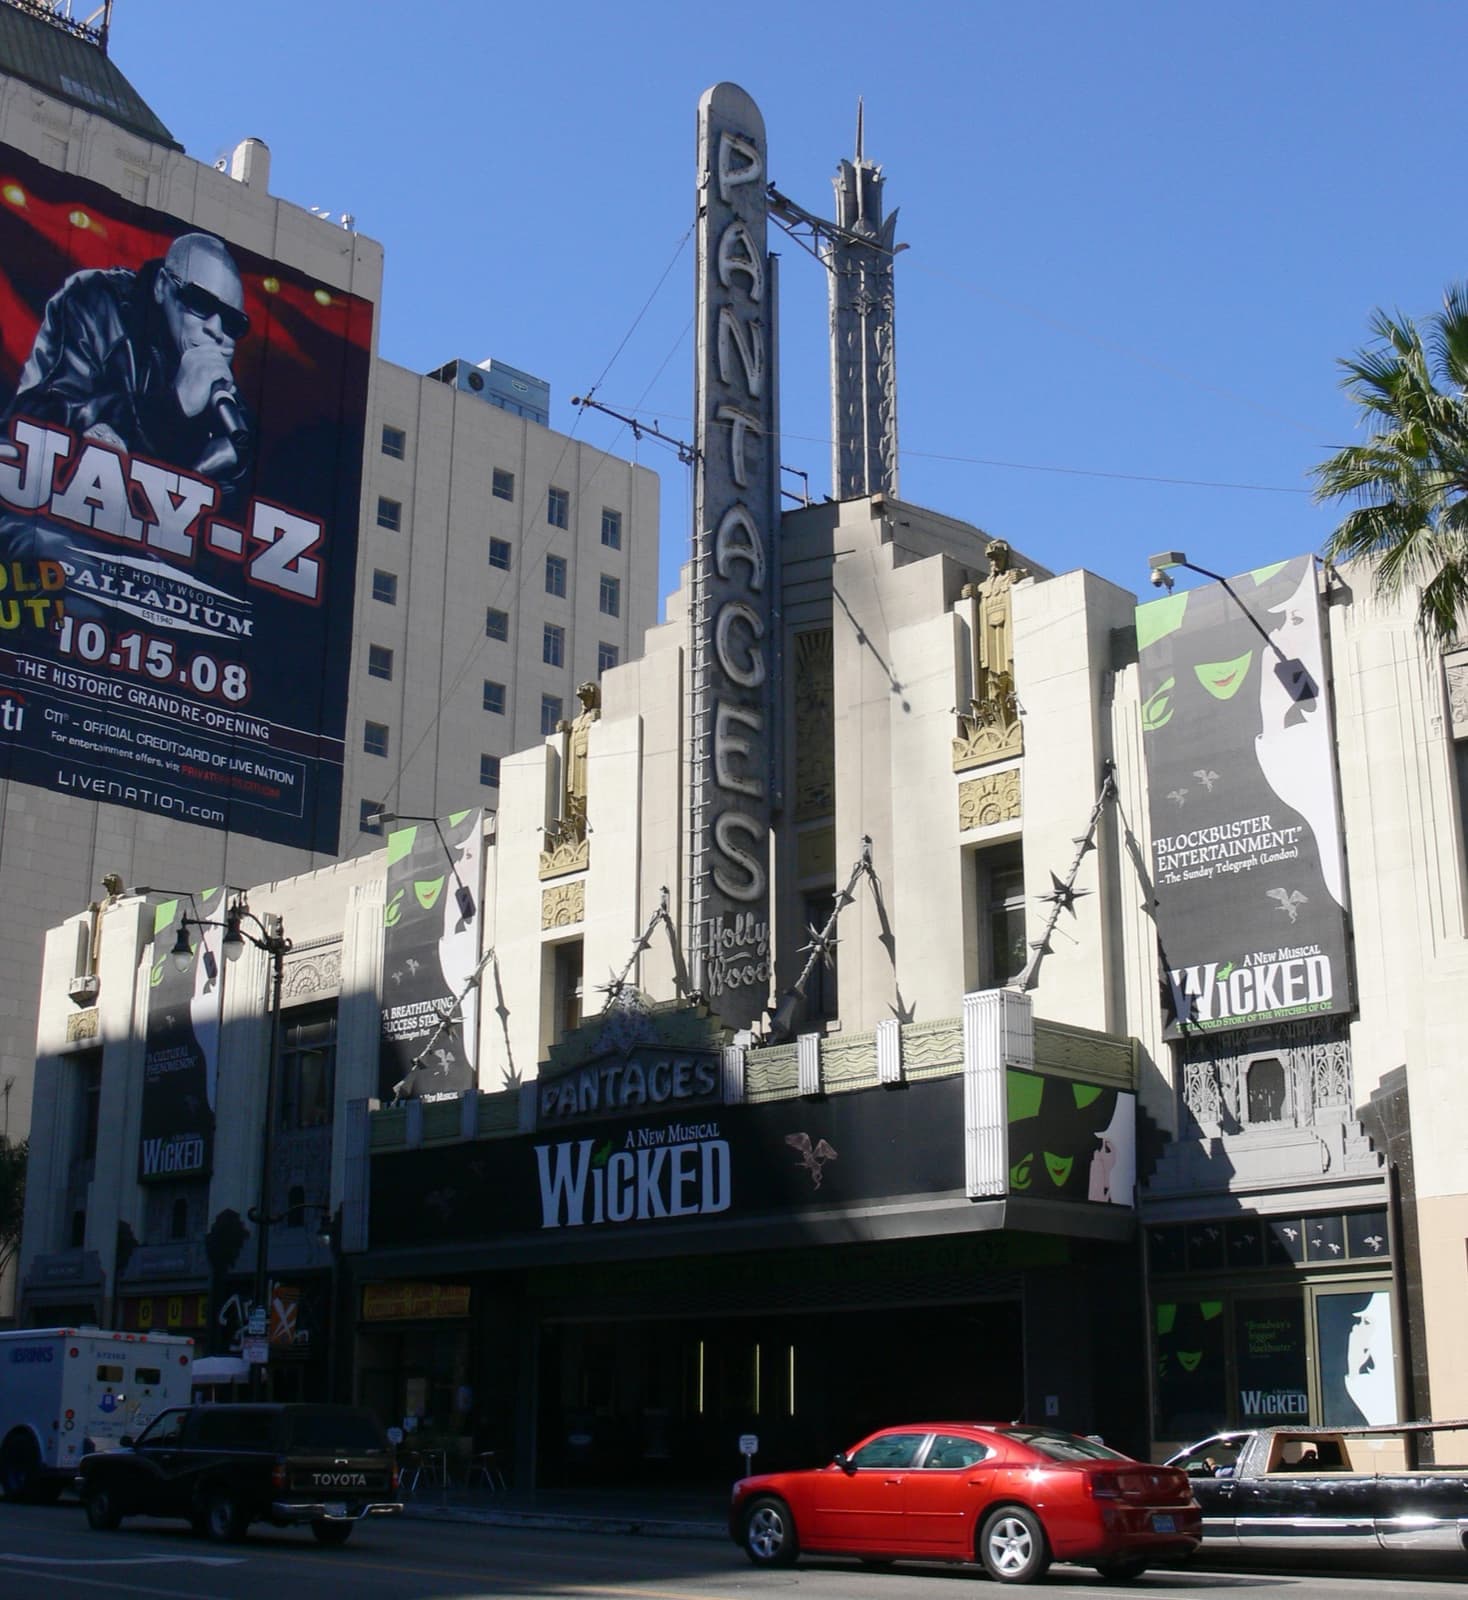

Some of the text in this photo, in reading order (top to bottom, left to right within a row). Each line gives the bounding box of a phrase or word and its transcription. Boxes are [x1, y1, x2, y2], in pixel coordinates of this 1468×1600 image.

[0, 420, 321, 599] JAY-Z
[713, 129, 766, 902] PANTAGES
[101, 562, 125, 577] THE
[58, 560, 254, 637] PALLADIUM
[55, 616, 248, 702] 10.15.08
[16, 659, 270, 739] THE HISTORIC GRAND RE-OPENING
[51, 730, 66, 742] For
[69, 737, 133, 758] entertainment
[83, 720, 135, 743] OFFICIAL
[212, 754, 228, 767] OF
[229, 758, 253, 773] LIVE
[254, 764, 295, 785] NATION
[1183, 865, 1214, 879] Sunday
[1216, 855, 1258, 873] Telegraph
[1260, 846, 1299, 865] (London)
[709, 911, 767, 957] Holly
[1243, 955, 1253, 967] A
[1223, 1015, 1248, 1026] STORY
[1247, 1013, 1257, 1023] OF
[1258, 1011, 1273, 1020] THE
[1274, 1005, 1308, 1017] WITCHES
[540, 1058, 717, 1117] PANTAGES
[624, 1130, 635, 1149] A
[312, 1473, 367, 1487] TOYOTA
